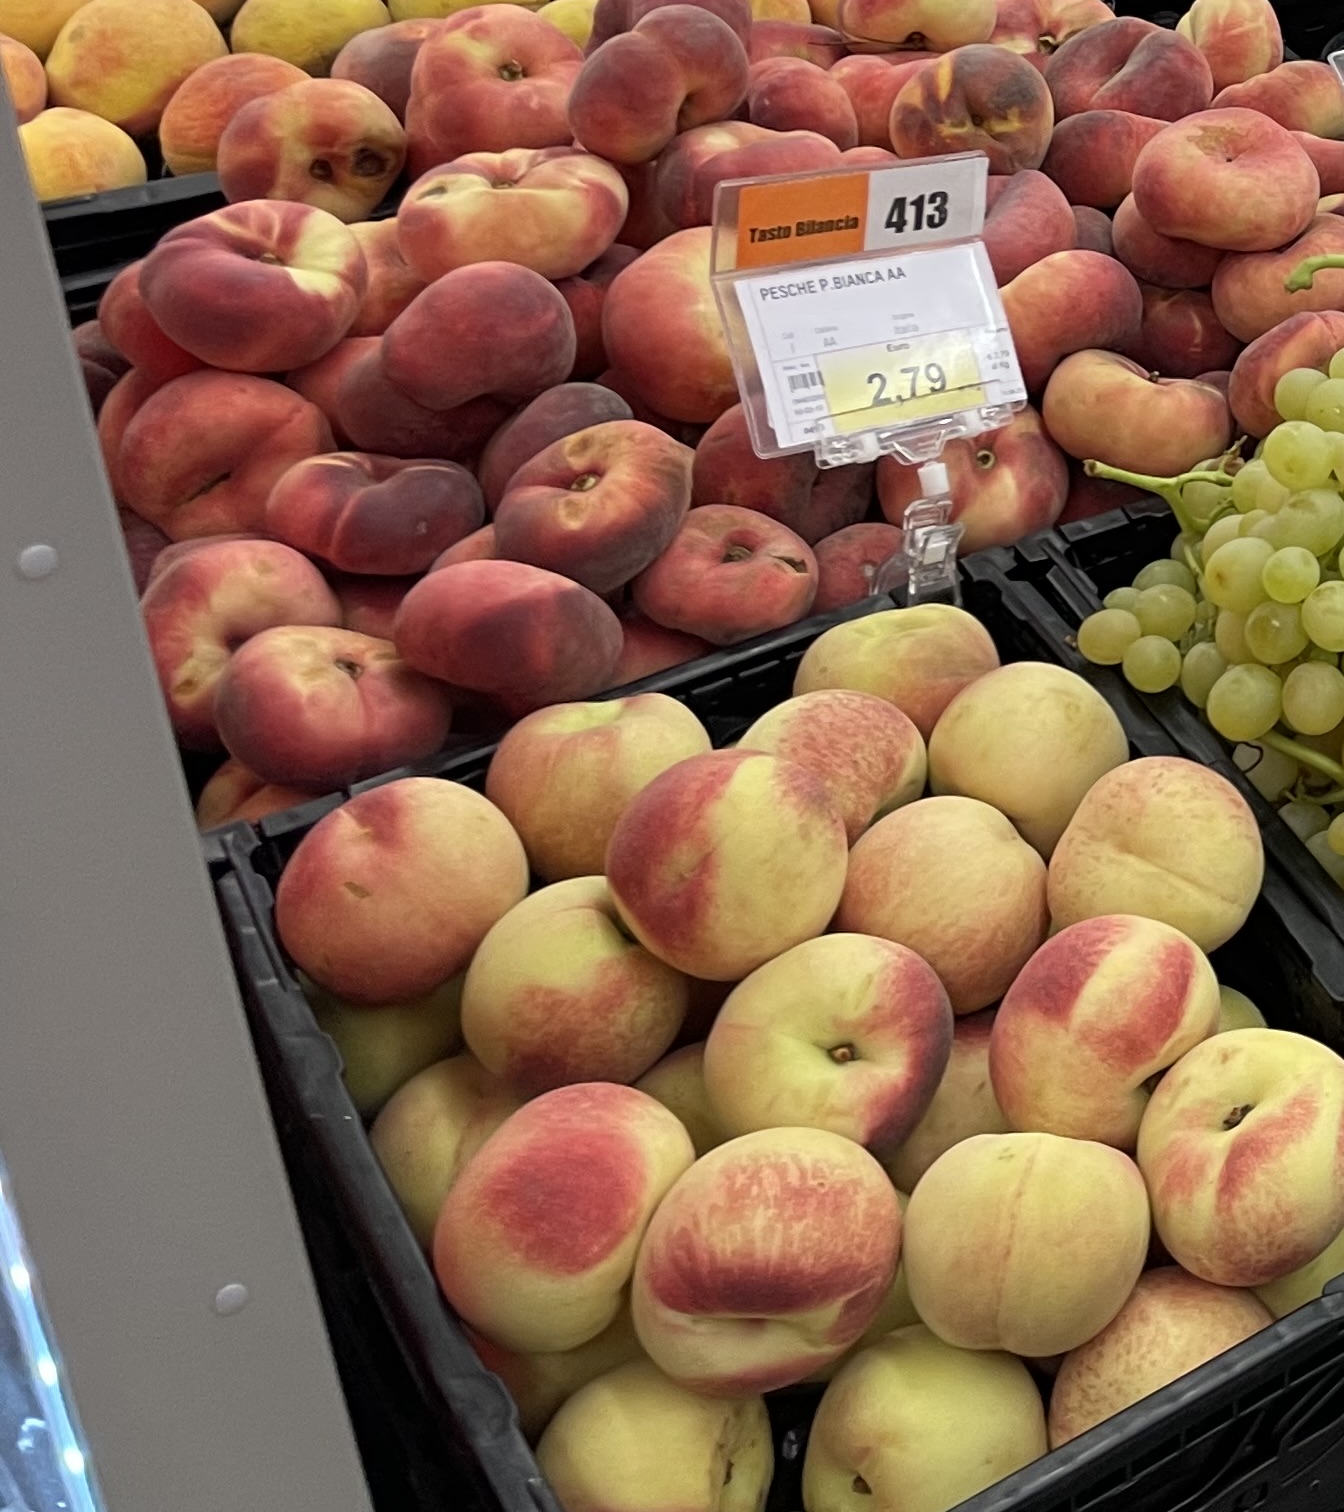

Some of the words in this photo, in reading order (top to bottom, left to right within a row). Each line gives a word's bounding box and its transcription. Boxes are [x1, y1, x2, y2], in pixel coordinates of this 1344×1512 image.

[750, 227, 791, 244] Tasto
[796, 215, 858, 237] Bilancia
[884, 191, 948, 234] 413
[760, 280, 817, 301] PESCHE
[887, 267, 906, 280] AA
[867, 362, 946, 407] 2,79
